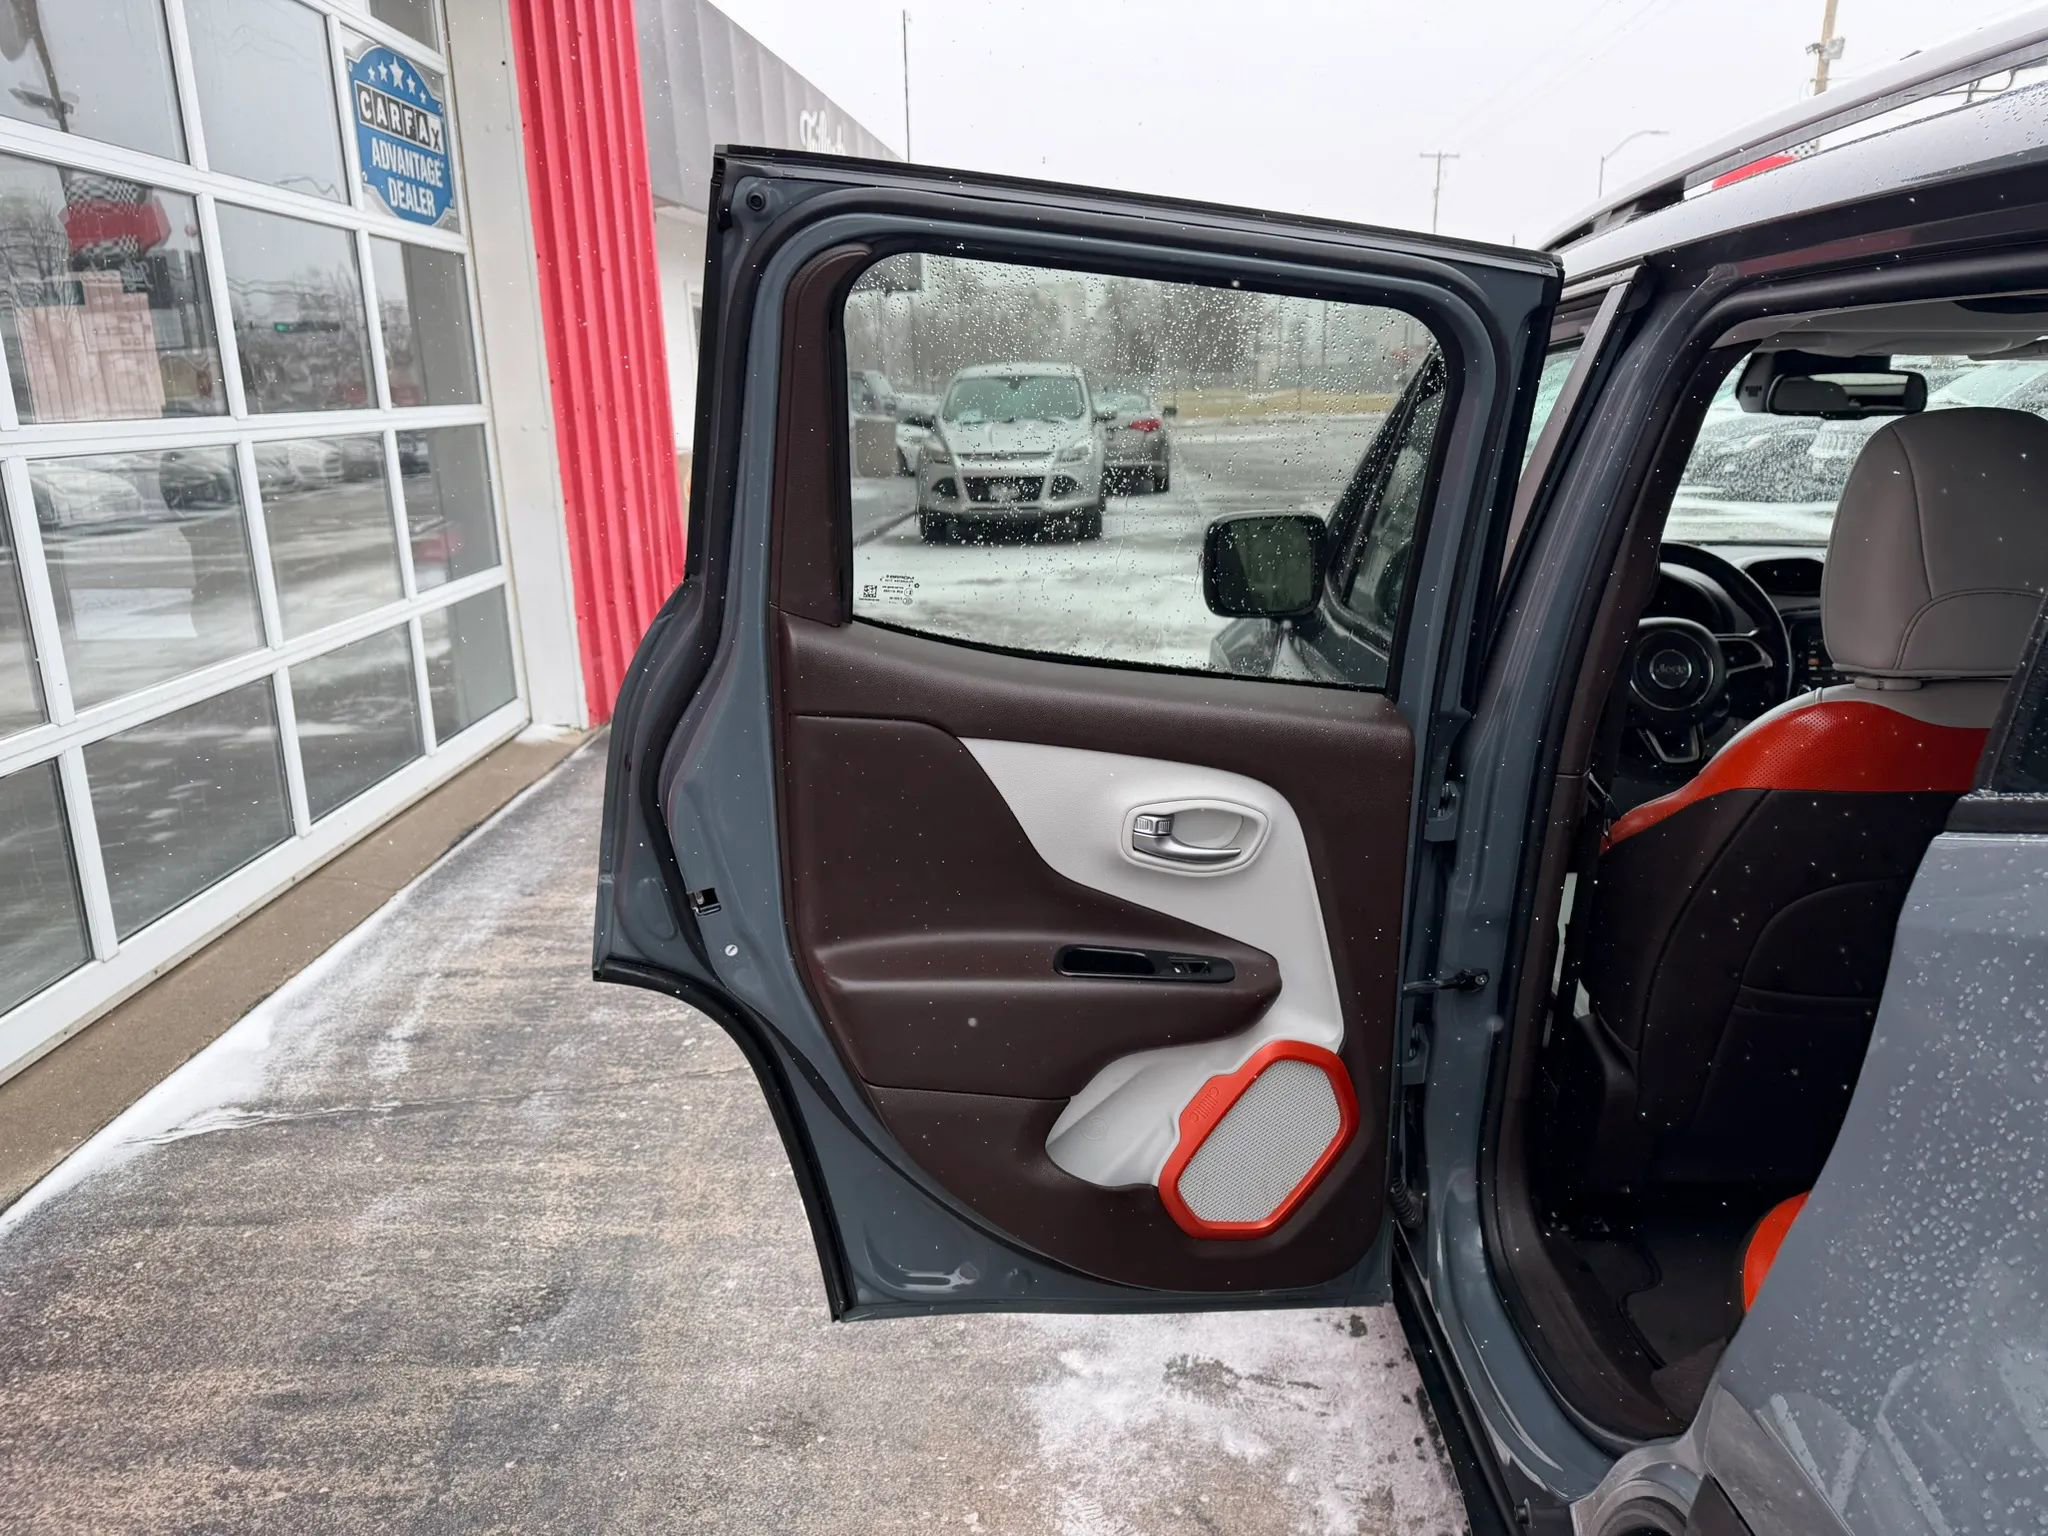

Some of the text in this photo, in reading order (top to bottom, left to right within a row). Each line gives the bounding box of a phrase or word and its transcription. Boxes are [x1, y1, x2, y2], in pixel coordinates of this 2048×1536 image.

[359, 90, 442, 150] CARFAX
[371, 137, 443, 188] ADVANTAGE
[388, 177, 436, 217] DEALER
